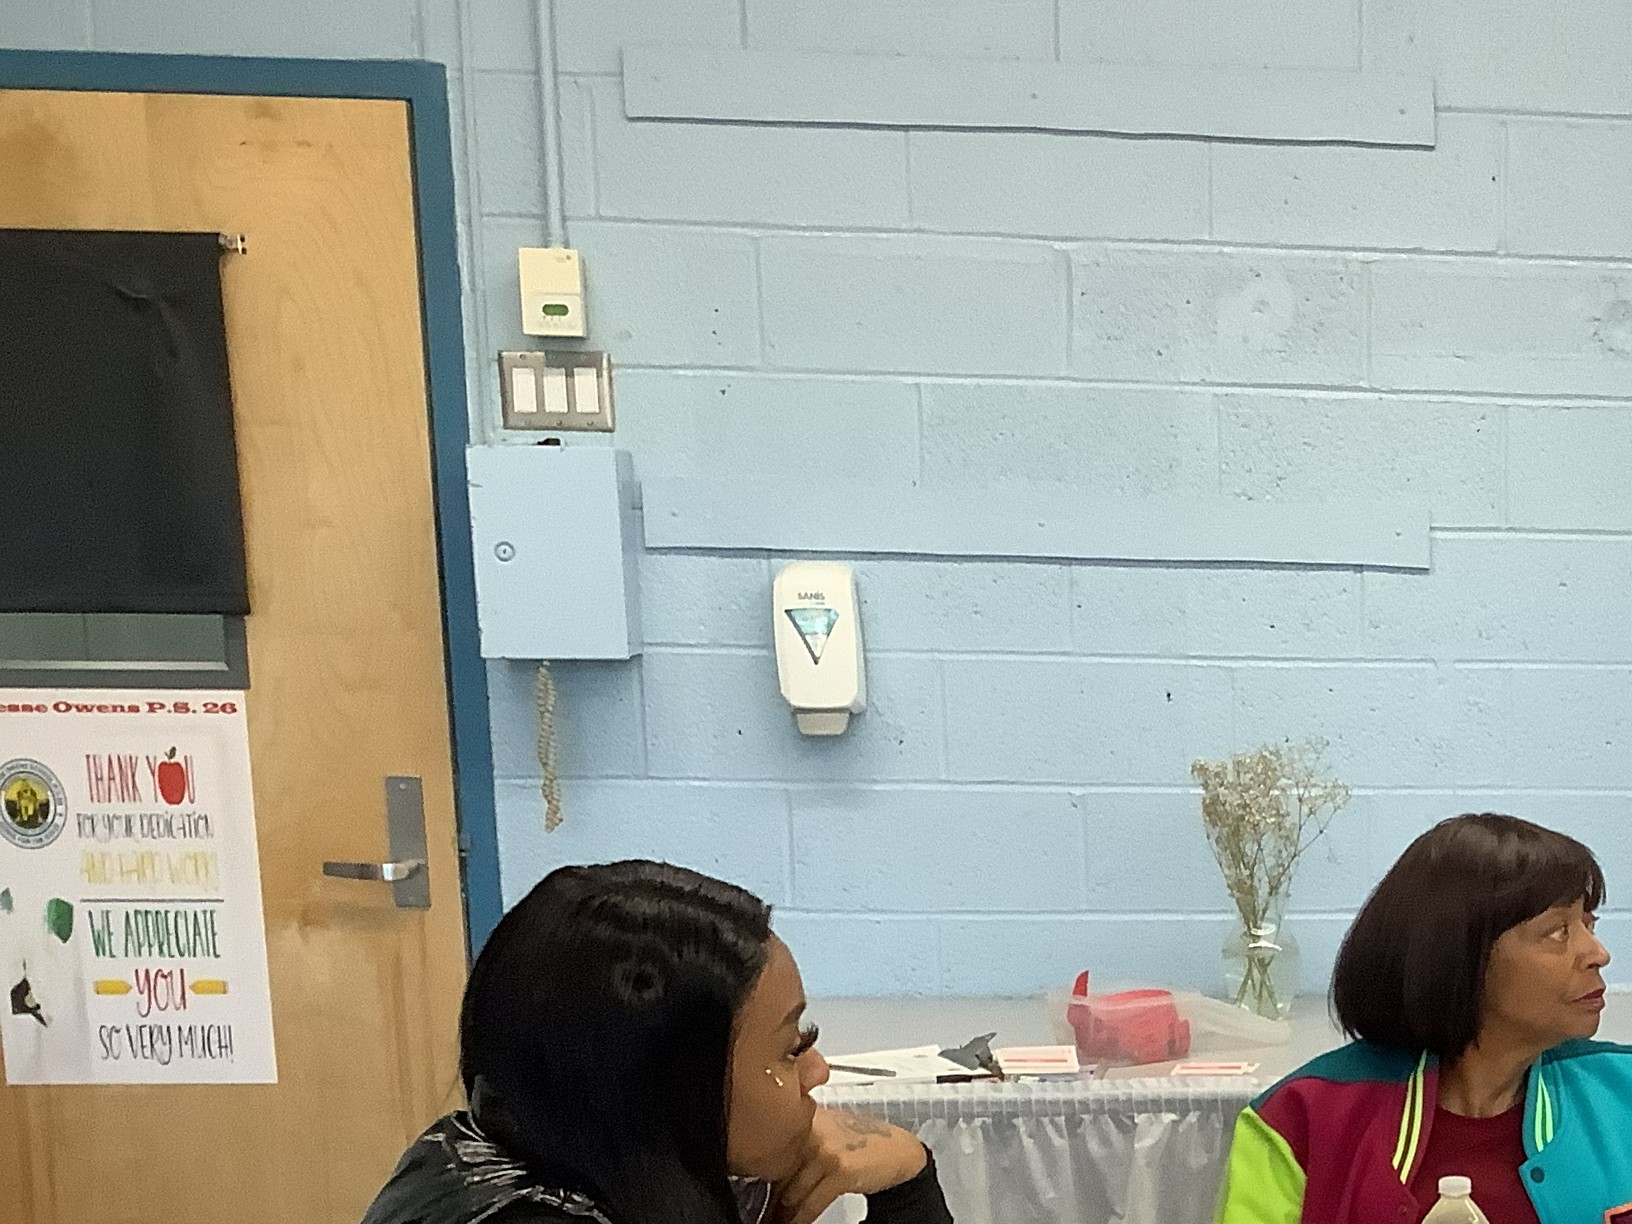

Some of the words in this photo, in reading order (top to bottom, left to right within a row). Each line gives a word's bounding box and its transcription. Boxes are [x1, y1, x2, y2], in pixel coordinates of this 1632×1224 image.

[52, 701, 141, 714] Owens
[146, 701, 197, 714] P.S.
[203, 702, 238, 714] 26
[85, 753, 142, 804] THANK
[88, 909, 117, 958] WE
[124, 909, 221, 958] APPRECIATE
[135, 967, 187, 1018] YOU
[98, 1024, 122, 1061] SO
[126, 1023, 173, 1066] VERY
[178, 1024, 235, 1064] MUCH!
